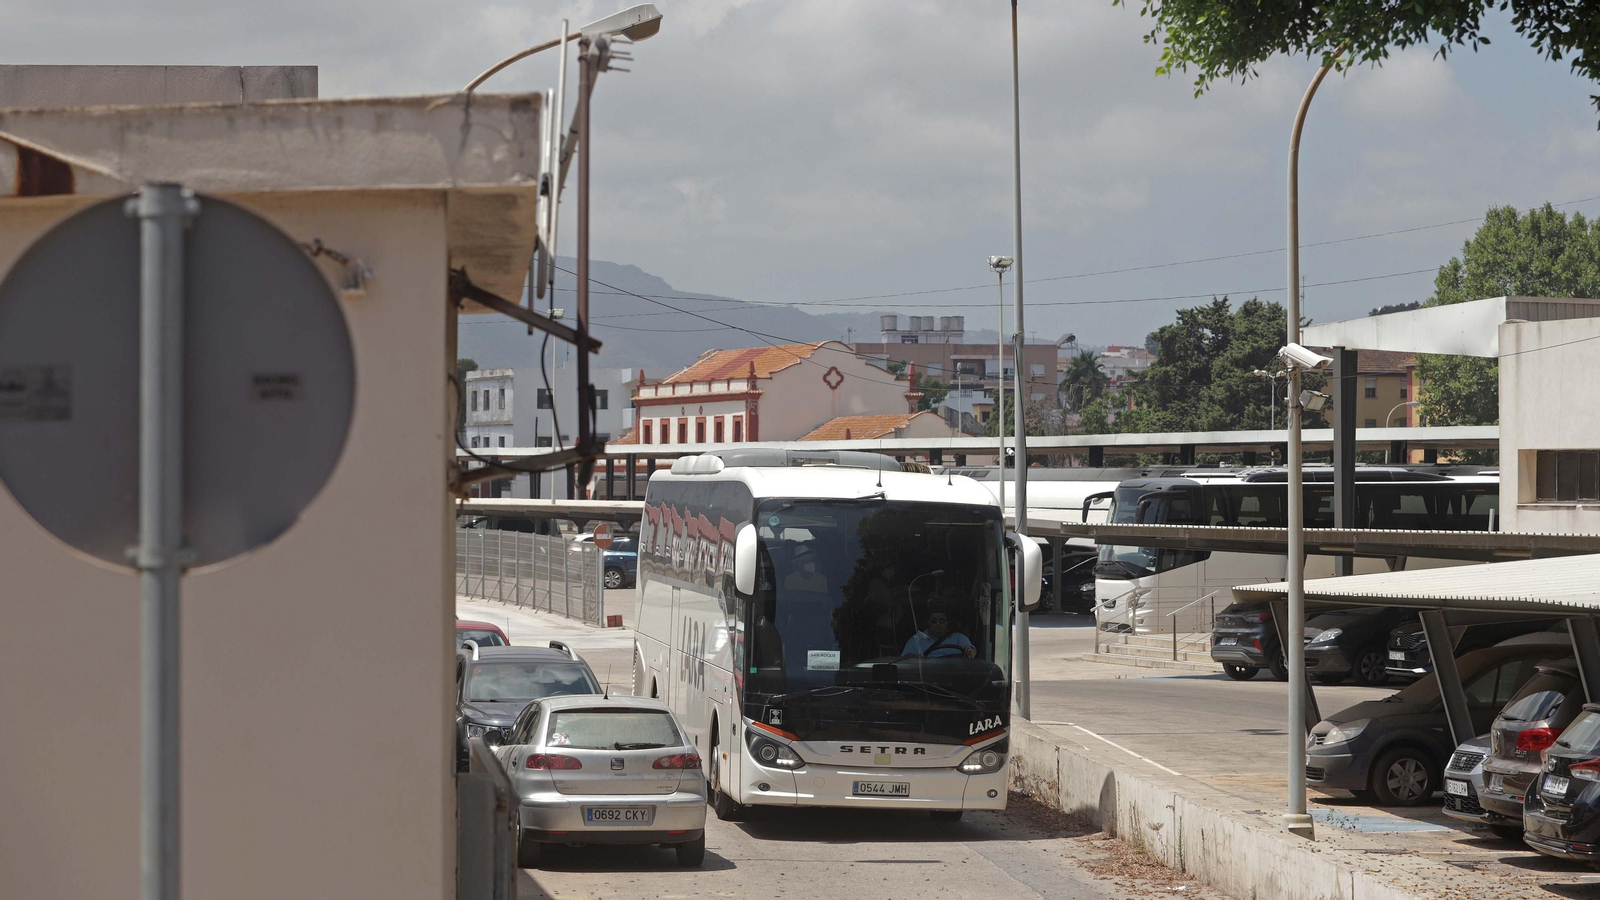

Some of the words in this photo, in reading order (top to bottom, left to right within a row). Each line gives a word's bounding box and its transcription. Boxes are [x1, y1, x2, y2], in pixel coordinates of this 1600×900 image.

[680, 615, 705, 692] LARA
[969, 714, 1002, 735] LARA
[840, 745, 926, 755] SETRA
[860, 783, 885, 793] 0544
[888, 784, 907, 794] JMH
[594, 810, 621, 820] 0692
[625, 810, 646, 820] CKY
